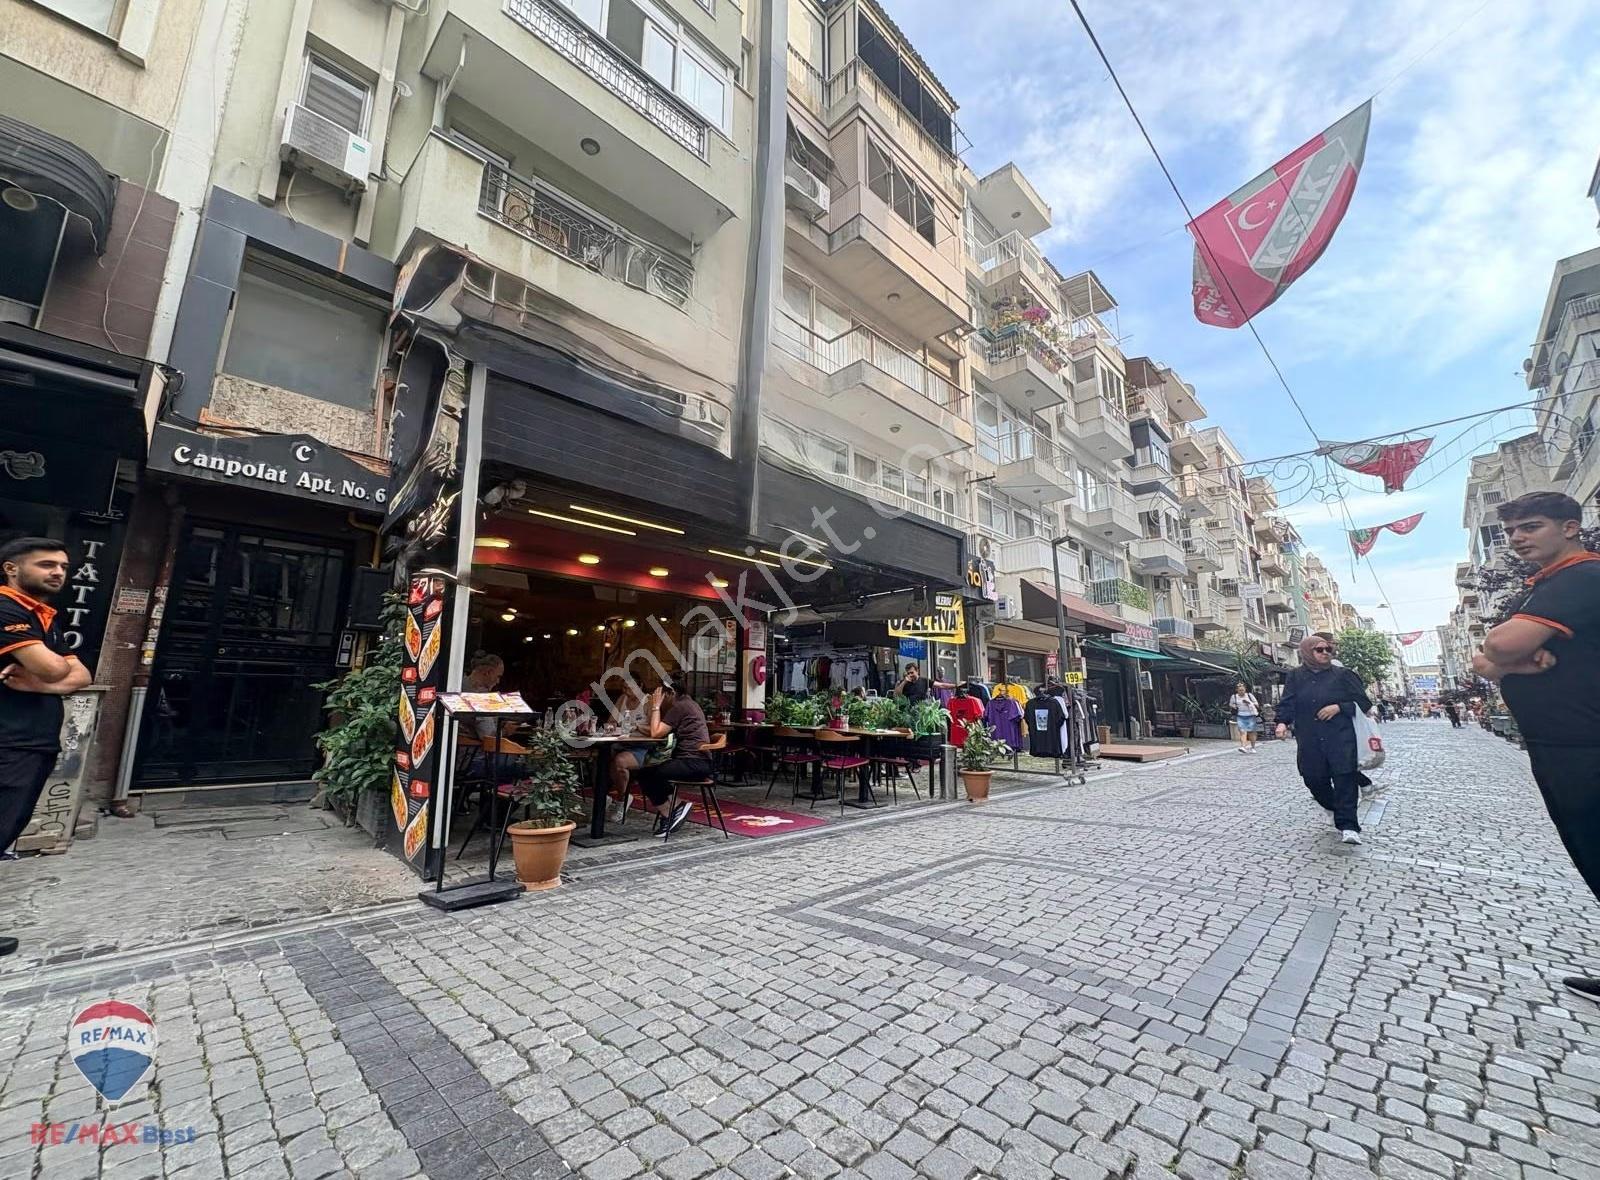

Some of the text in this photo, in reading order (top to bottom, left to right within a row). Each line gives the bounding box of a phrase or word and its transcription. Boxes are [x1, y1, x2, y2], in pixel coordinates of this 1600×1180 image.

[174, 446, 386, 503] Canpolat Apt. No. 6
